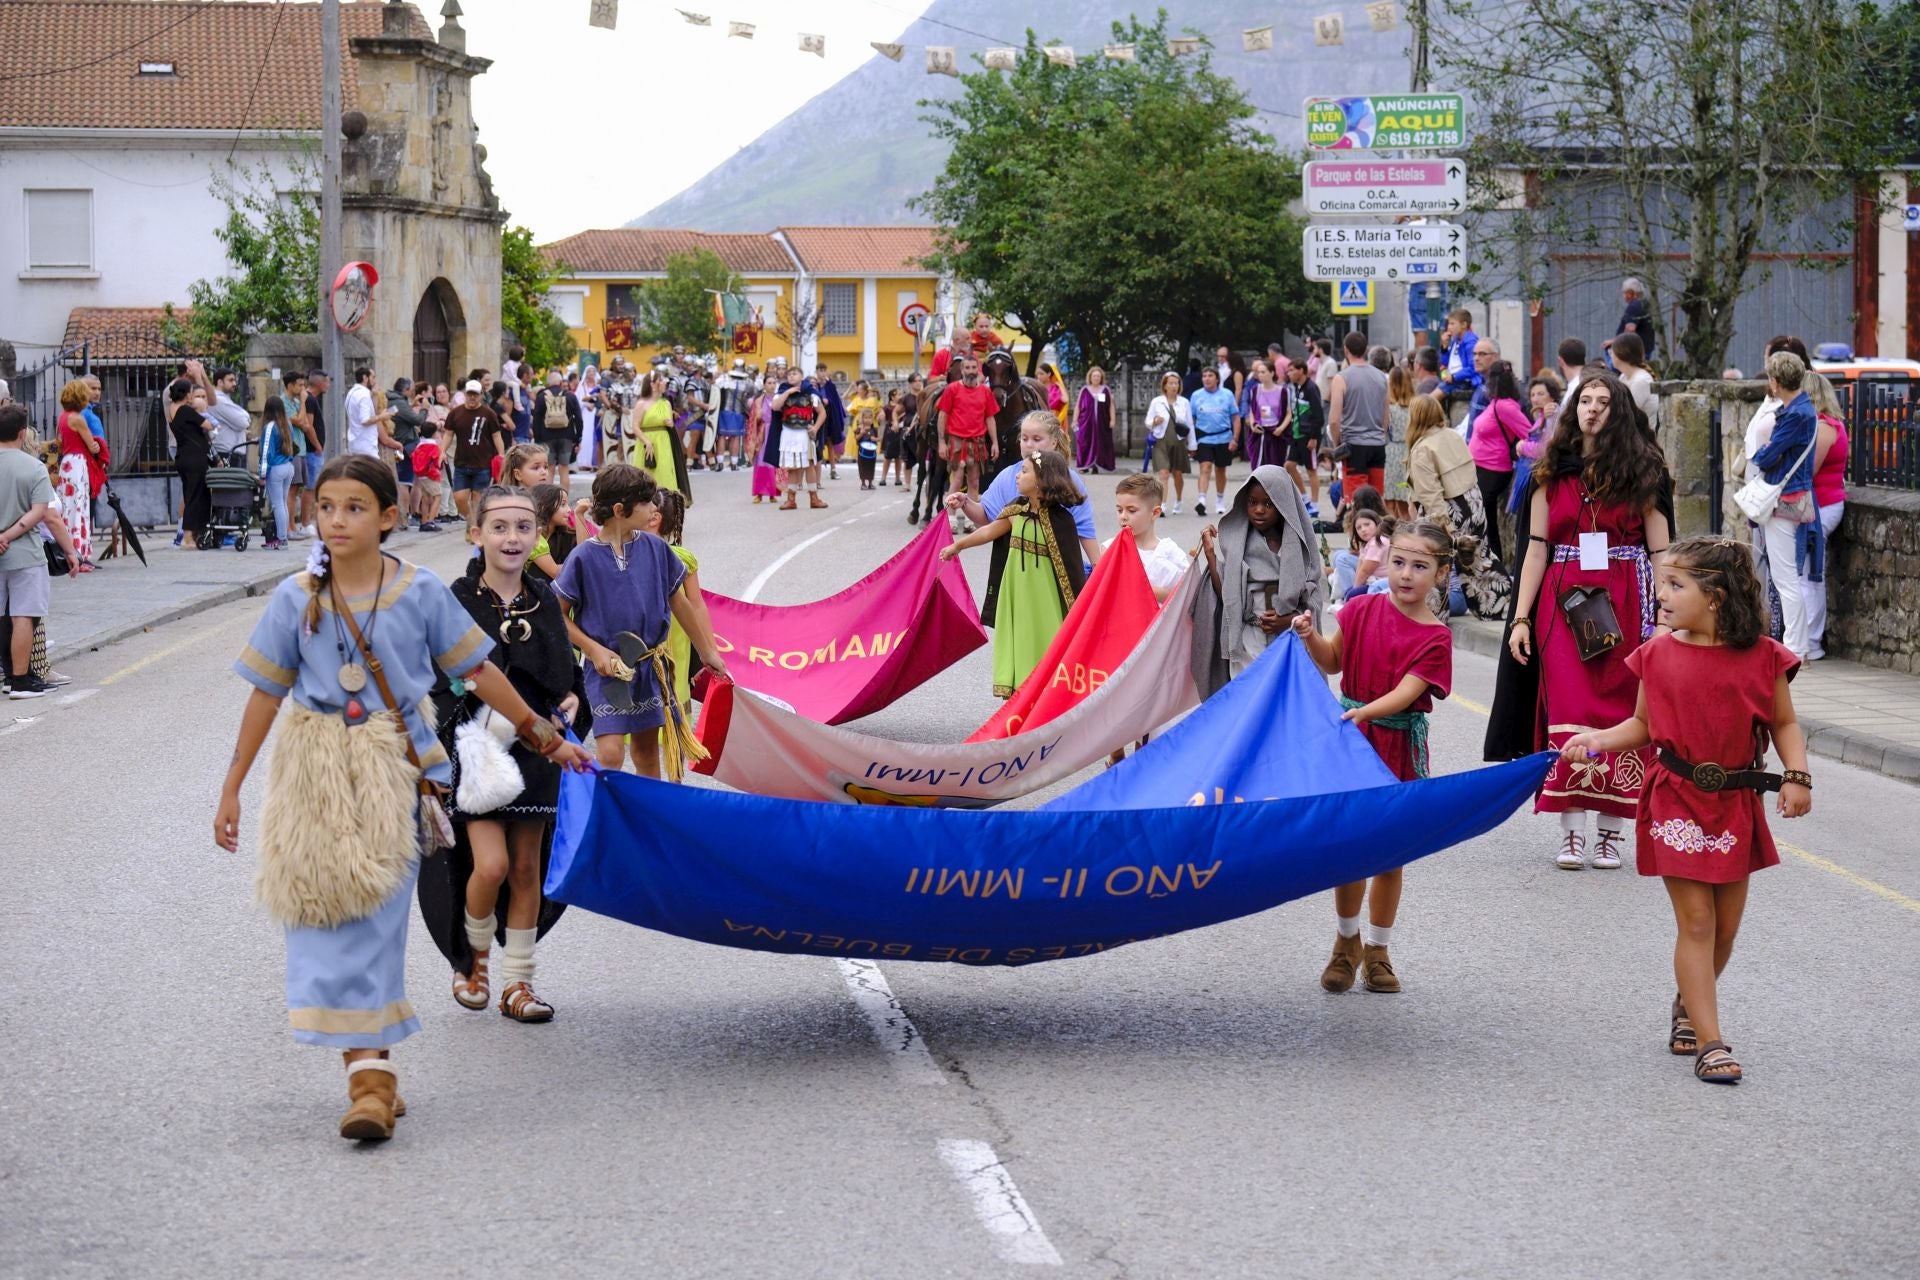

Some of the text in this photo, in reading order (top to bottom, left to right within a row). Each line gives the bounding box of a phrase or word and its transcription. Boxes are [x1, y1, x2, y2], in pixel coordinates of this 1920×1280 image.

[1376, 98, 1458, 112] ANÚNCIATE
[1308, 111, 1341, 122] TE VEN
[1379, 110, 1455, 130] AQUÍ
[1312, 123, 1336, 132] NO
[1389, 130, 1458, 145] 619 472 758
[1316, 167, 1425, 184] Parque de las Estelas
[1367, 190, 1399, 199] O.C.A.
[1320, 199, 1447, 210] Oficina Comarcal Agraria
[1315, 230, 1350, 242] I.E.S.
[1395, 229, 1422, 241] Telo
[1316, 247, 1344, 258] I.E.S.
[1349, 247, 1386, 258] Estelas
[1390, 247, 1405, 257] del
[1316, 265, 1376, 277] Torrelavega
[905, 867, 1025, 899] MMII
[1105, 860, 1222, 898] AÑO
[724, 918, 912, 955] BUELNA
[928, 947, 992, 961] DE
